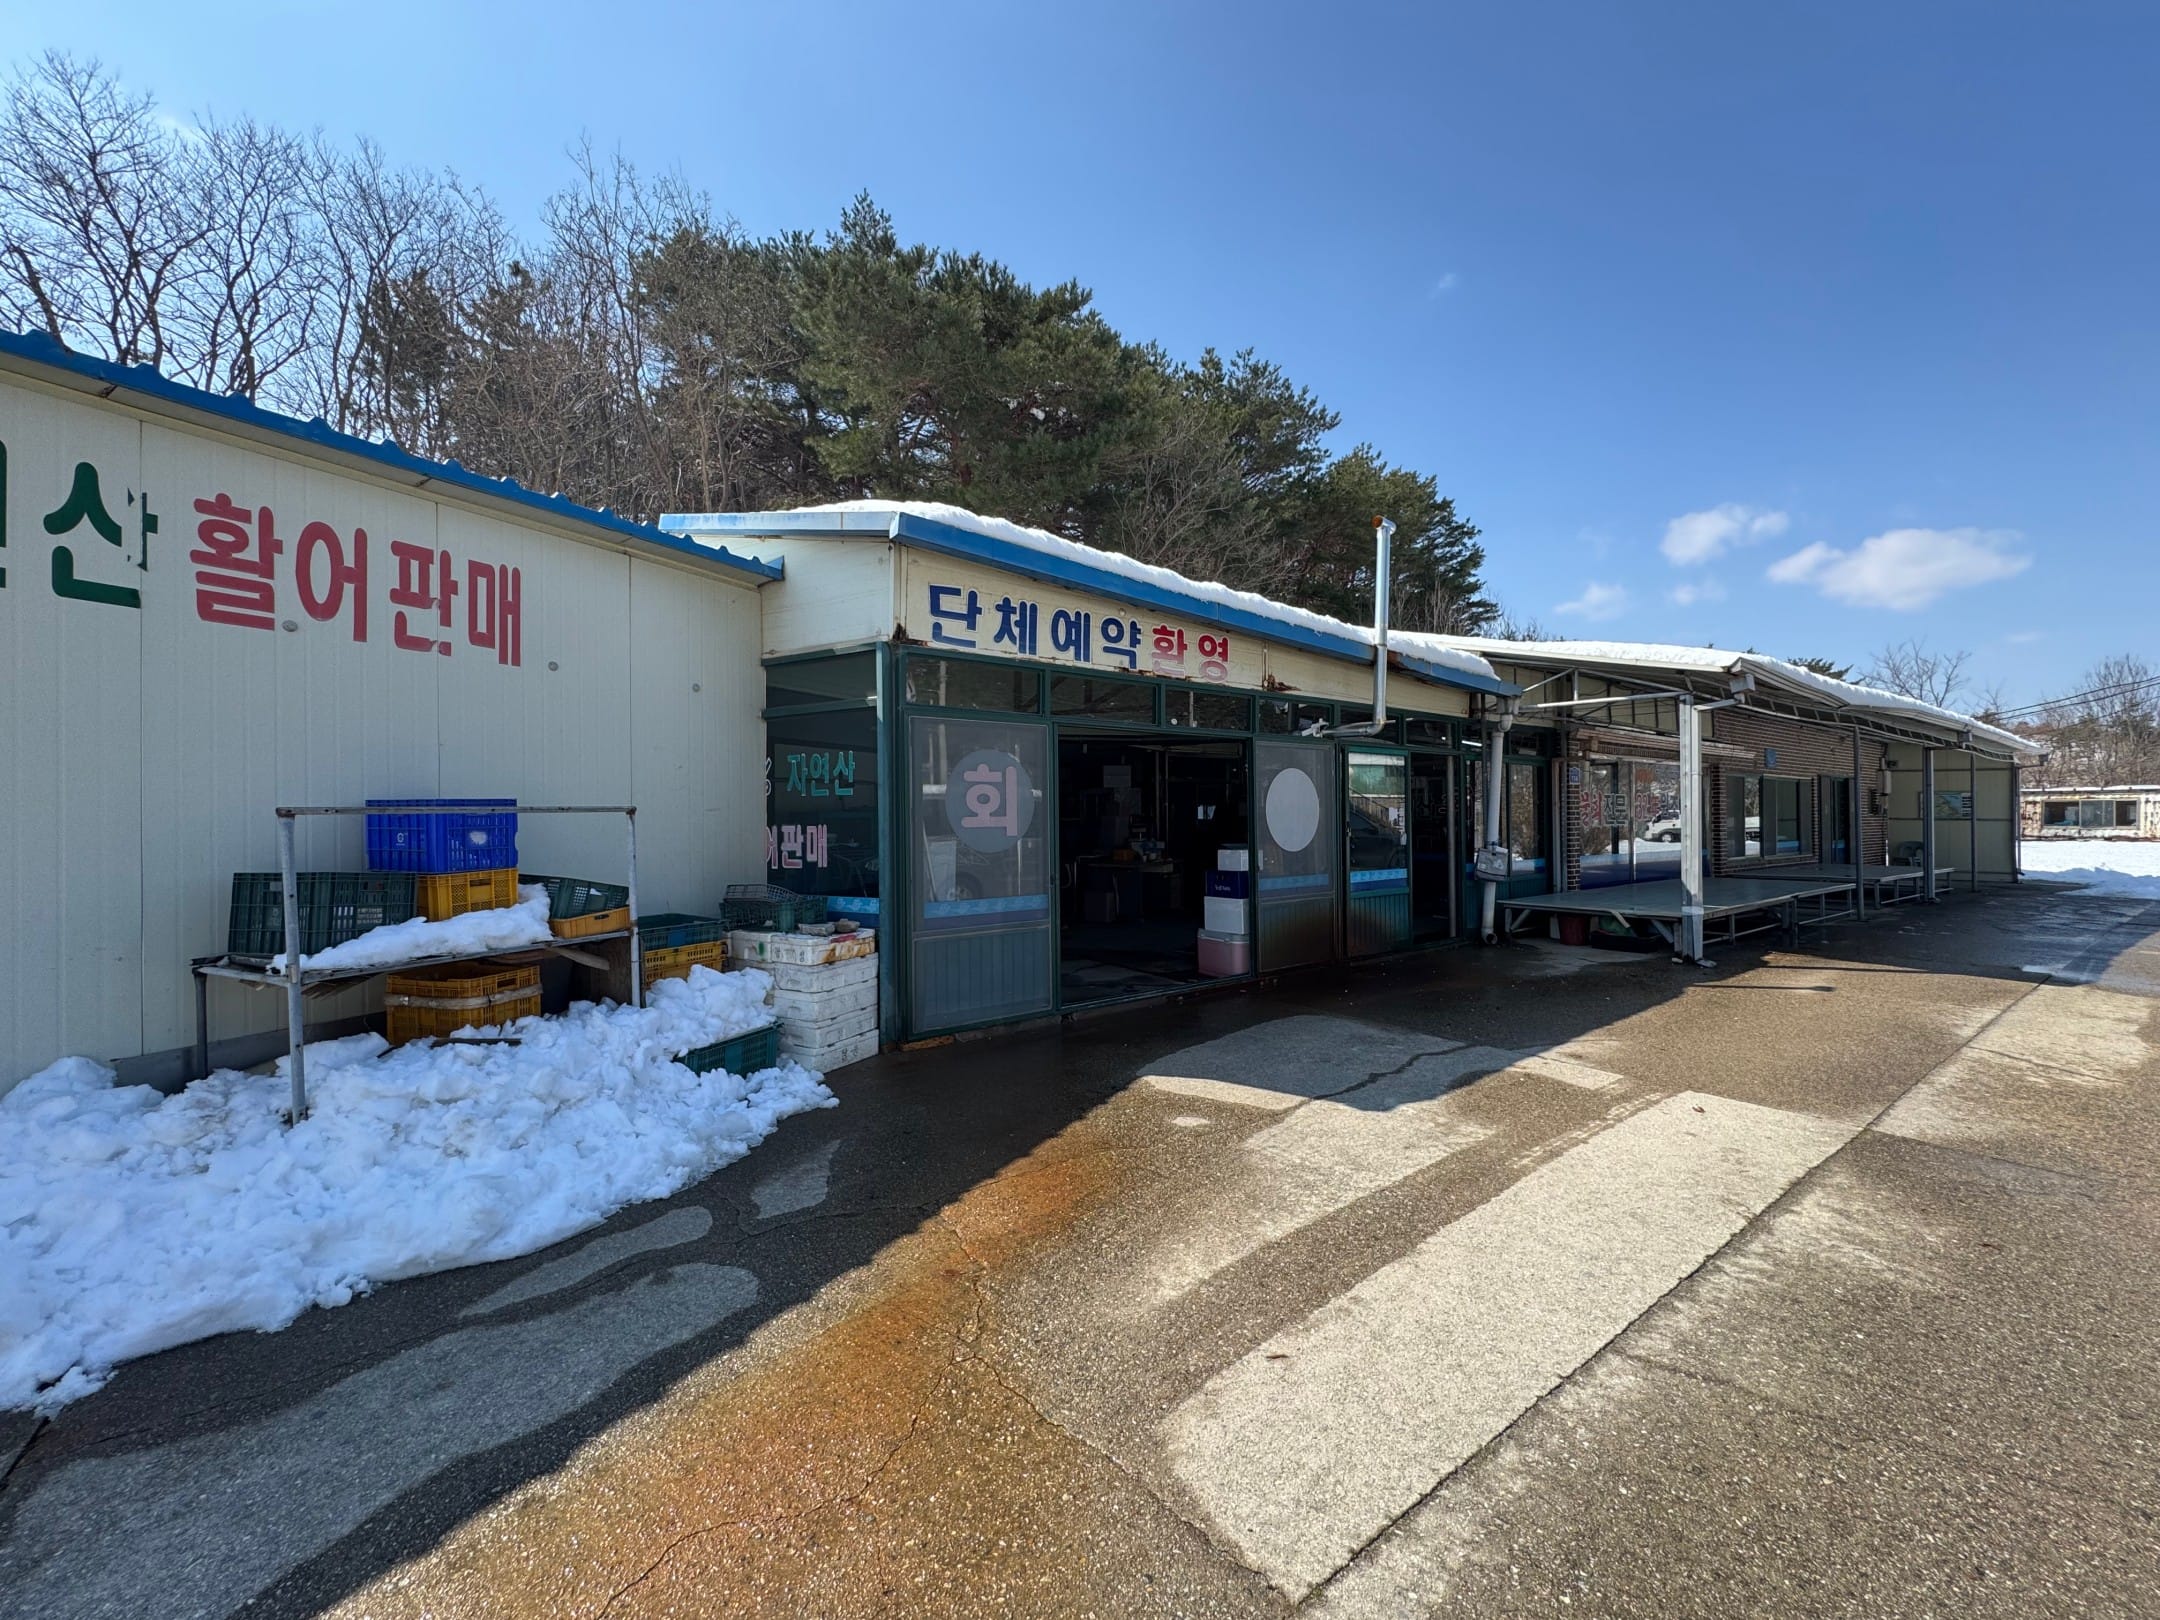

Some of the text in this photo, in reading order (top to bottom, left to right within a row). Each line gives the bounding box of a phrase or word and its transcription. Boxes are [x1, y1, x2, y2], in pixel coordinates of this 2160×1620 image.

[0, 440, 158, 609] 산
[1151, 623, 1230, 683] 환영
[786, 750, 856, 797] 자연산
[961, 763, 1018, 837] 회
